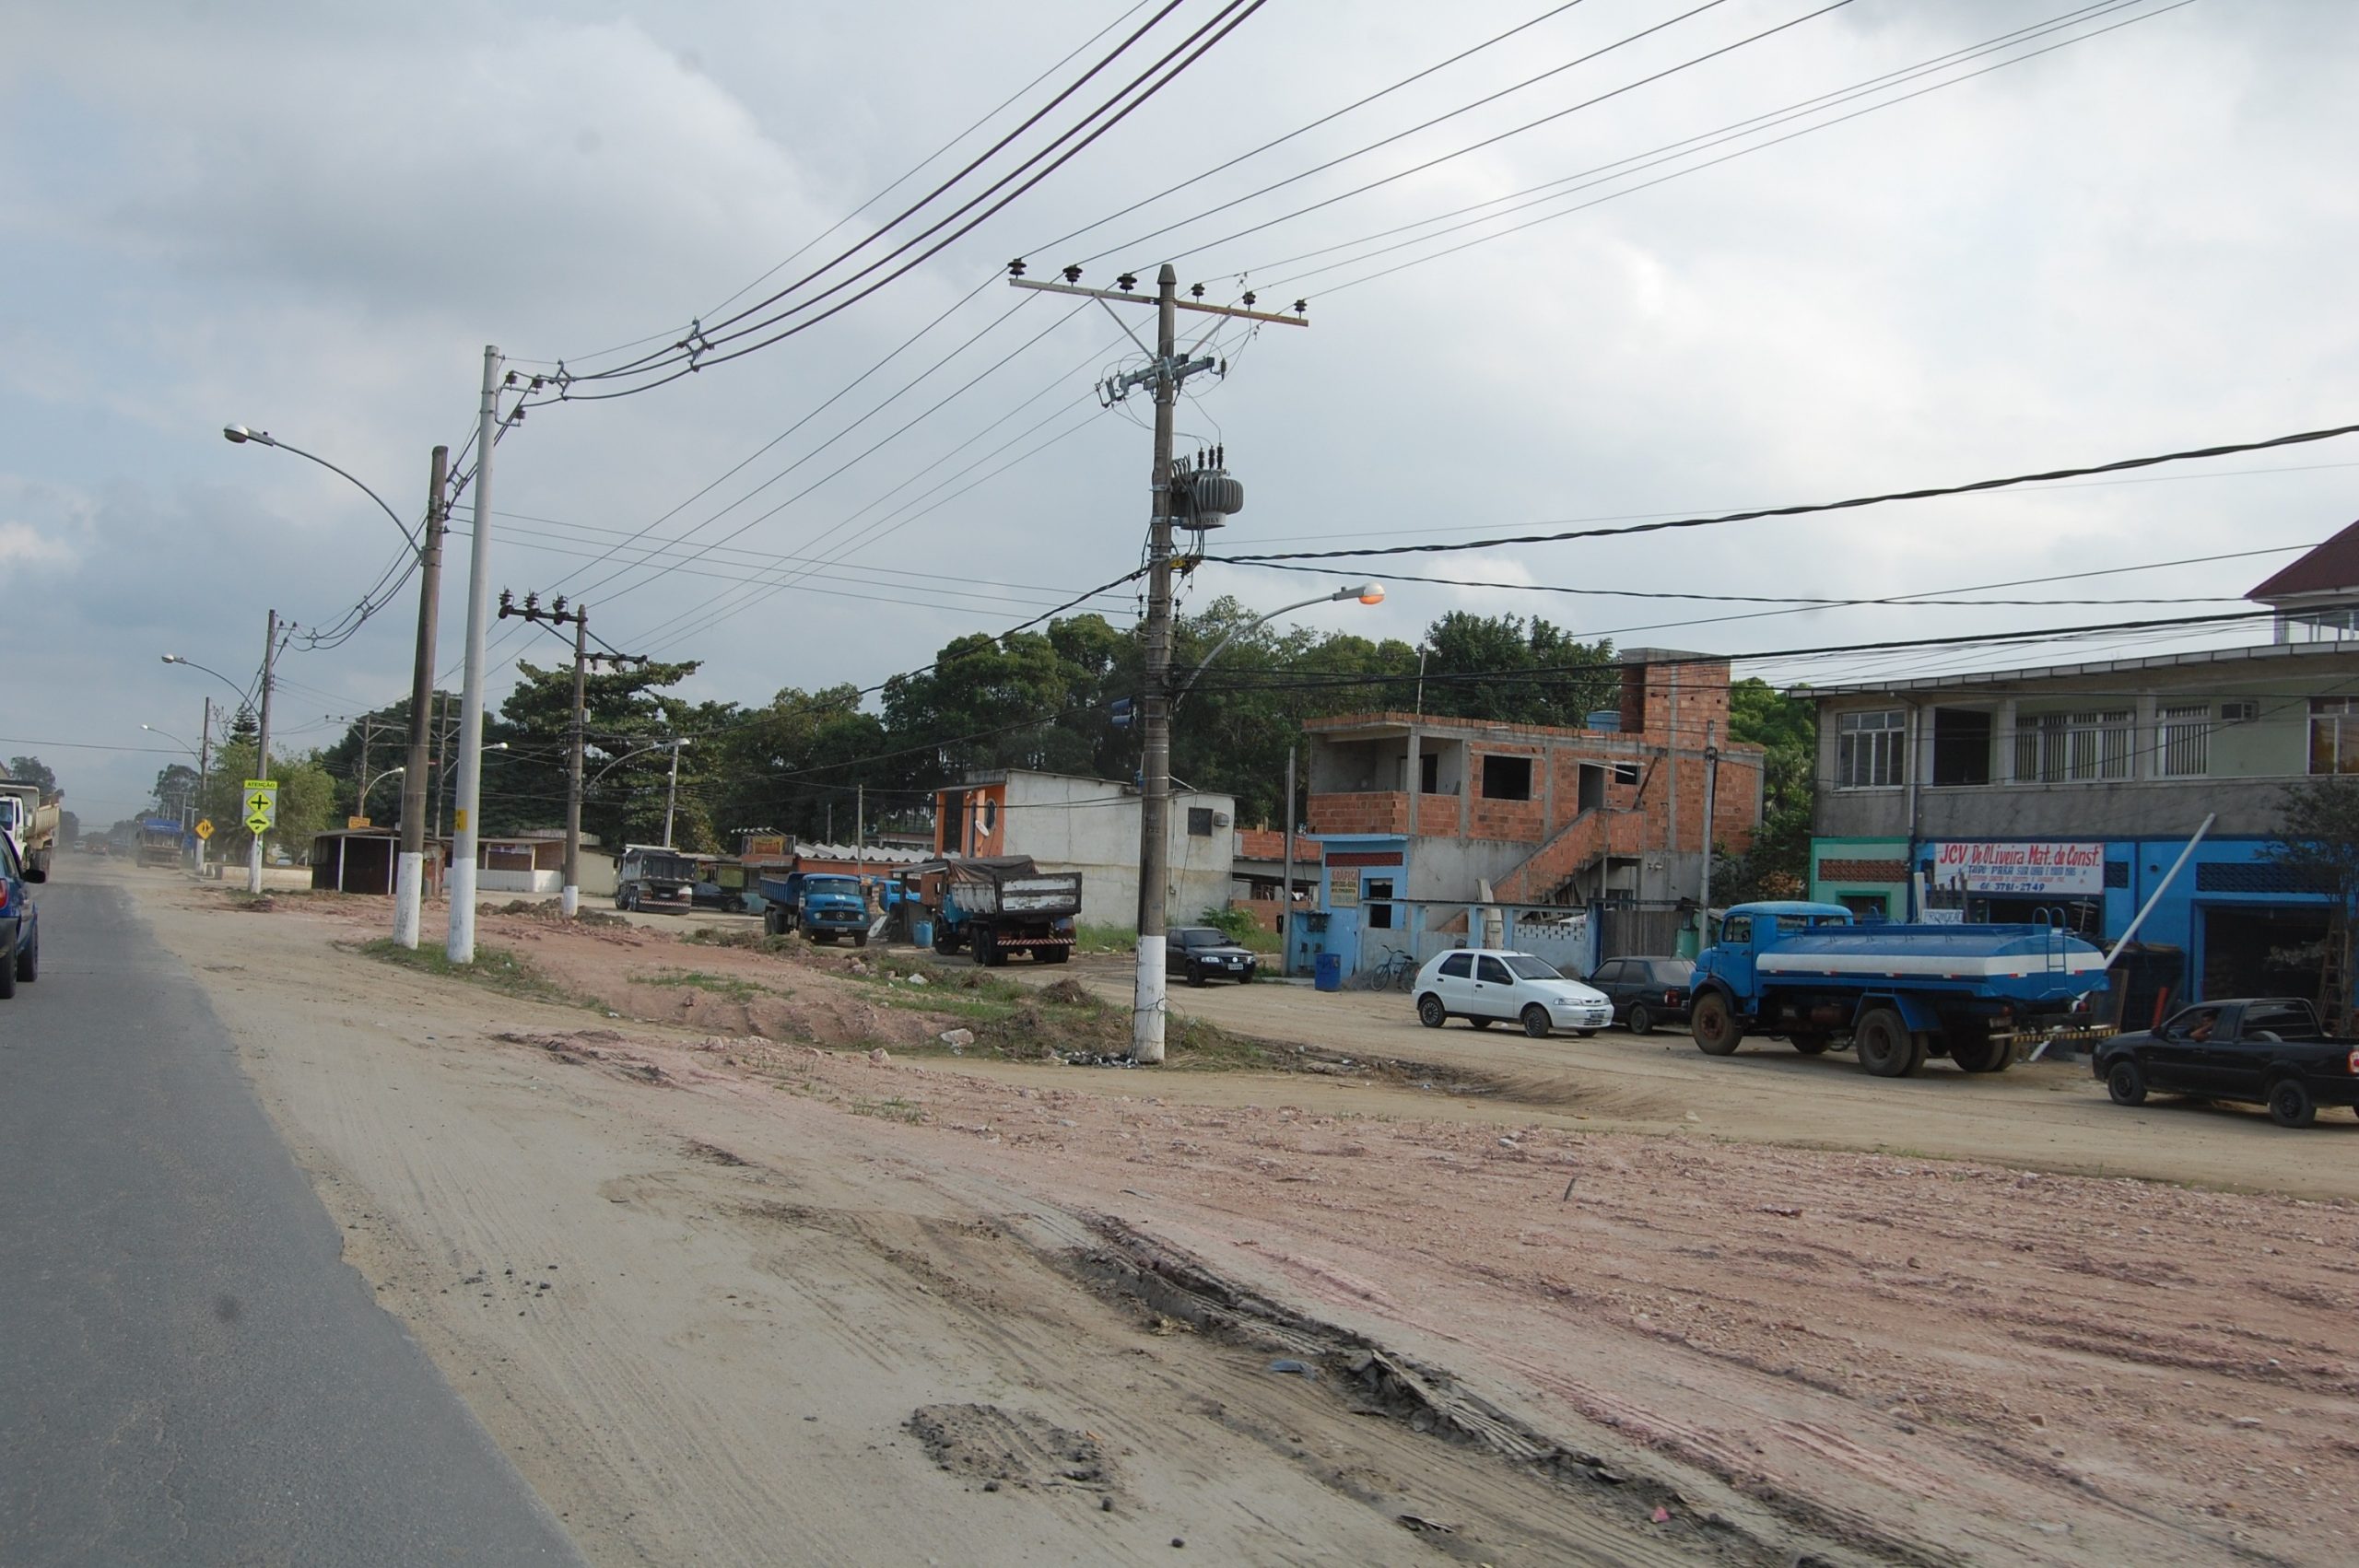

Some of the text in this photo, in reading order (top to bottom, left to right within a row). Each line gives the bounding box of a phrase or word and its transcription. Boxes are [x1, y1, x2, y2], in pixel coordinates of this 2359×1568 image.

[1940, 844, 1968, 864] JCV
[2028, 845, 2051, 865] Mat.
[2054, 845, 2066, 866] de
[1991, 866, 2013, 874] PARA
